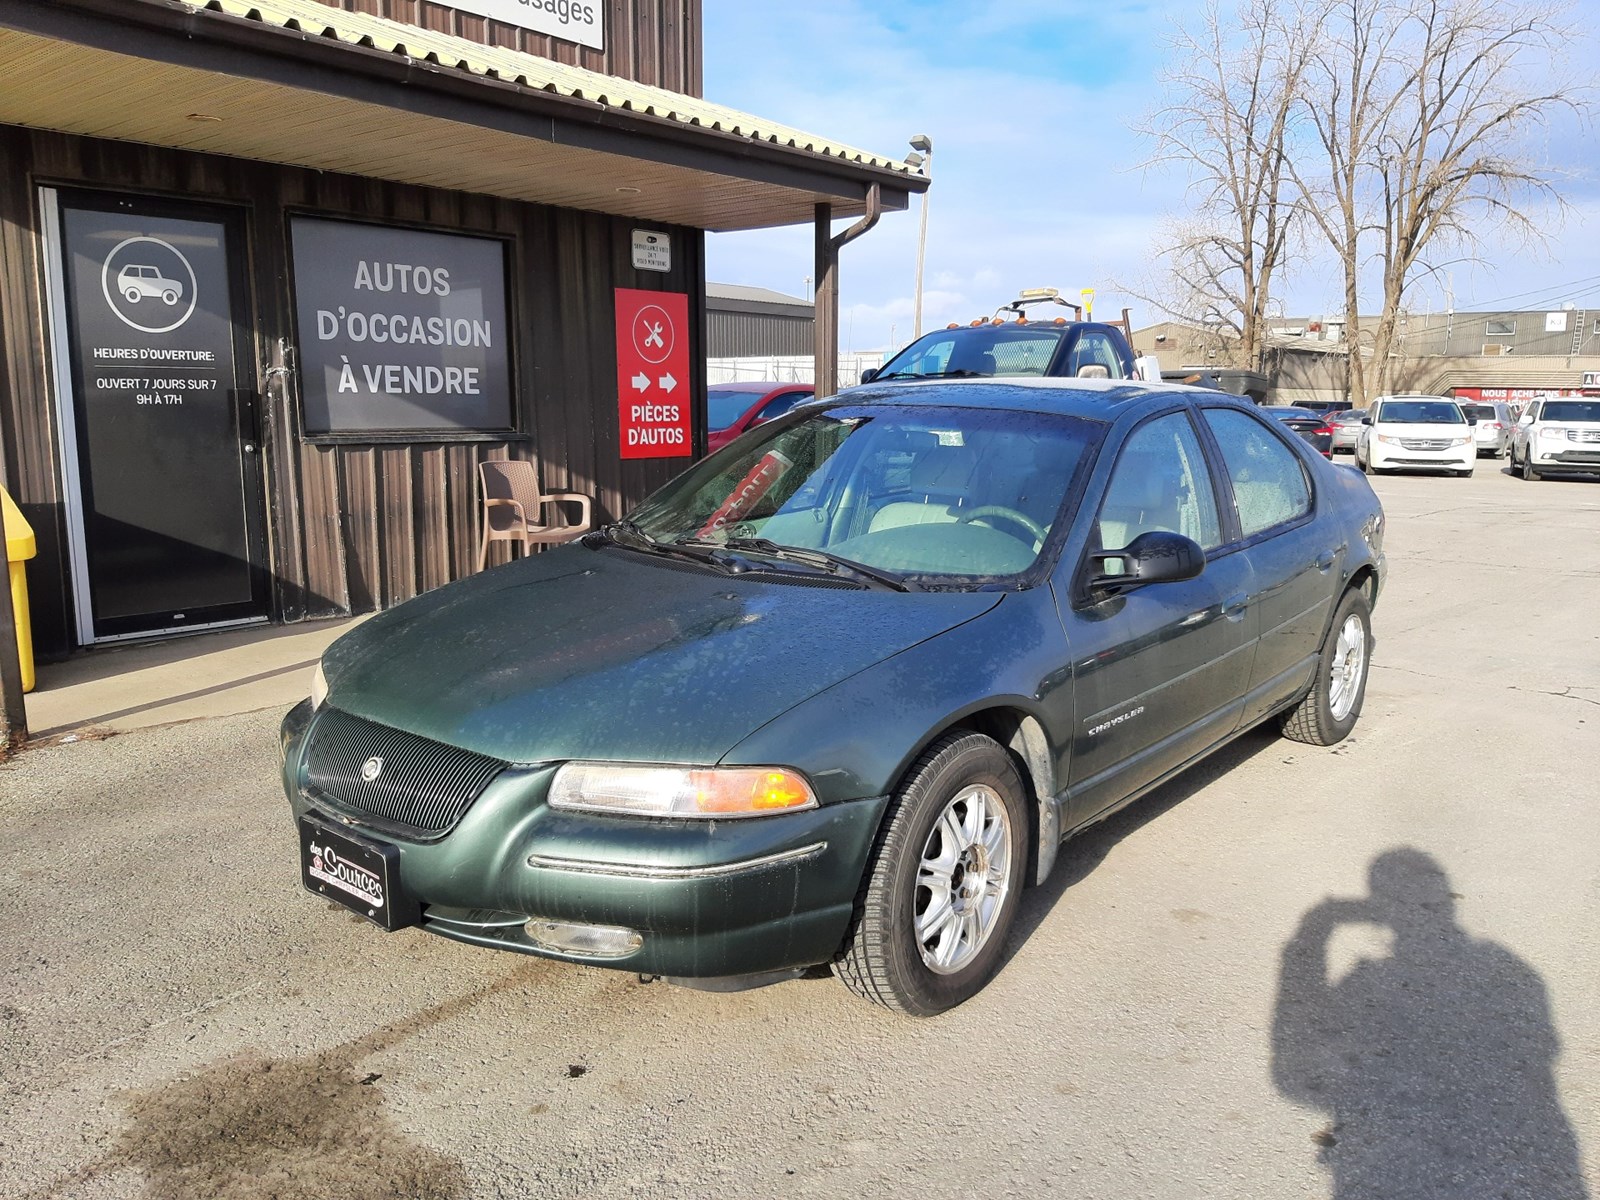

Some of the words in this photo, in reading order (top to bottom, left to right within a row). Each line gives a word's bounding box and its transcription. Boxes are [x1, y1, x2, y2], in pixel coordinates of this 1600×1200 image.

[354, 260, 450, 297] AUTOS
[317, 305, 492, 348] D'OCCASION
[93, 347, 138, 359] HEURES
[140, 347, 215, 361] D'OUVERTURE:
[96, 378, 141, 389] OUVERT
[142, 379, 150, 389] 7
[151, 379, 186, 390] JOURS
[187, 380, 209, 390] SUR
[210, 380, 217, 390] 7
[338, 354, 359, 394] À
[362, 364, 481, 395] VENDRE
[136, 394, 152, 405] 9H
[154, 391, 162, 405] À
[163, 394, 183, 405] 17H
[1481, 389, 1508, 398] NOUS
[631, 400, 679, 422] PIÈCES
[628, 426, 684, 446] D'AUTOS
[1088, 706, 1144, 737] CHRYSLER
[310, 841, 323, 857] des
[324, 846, 384, 904] Sources
